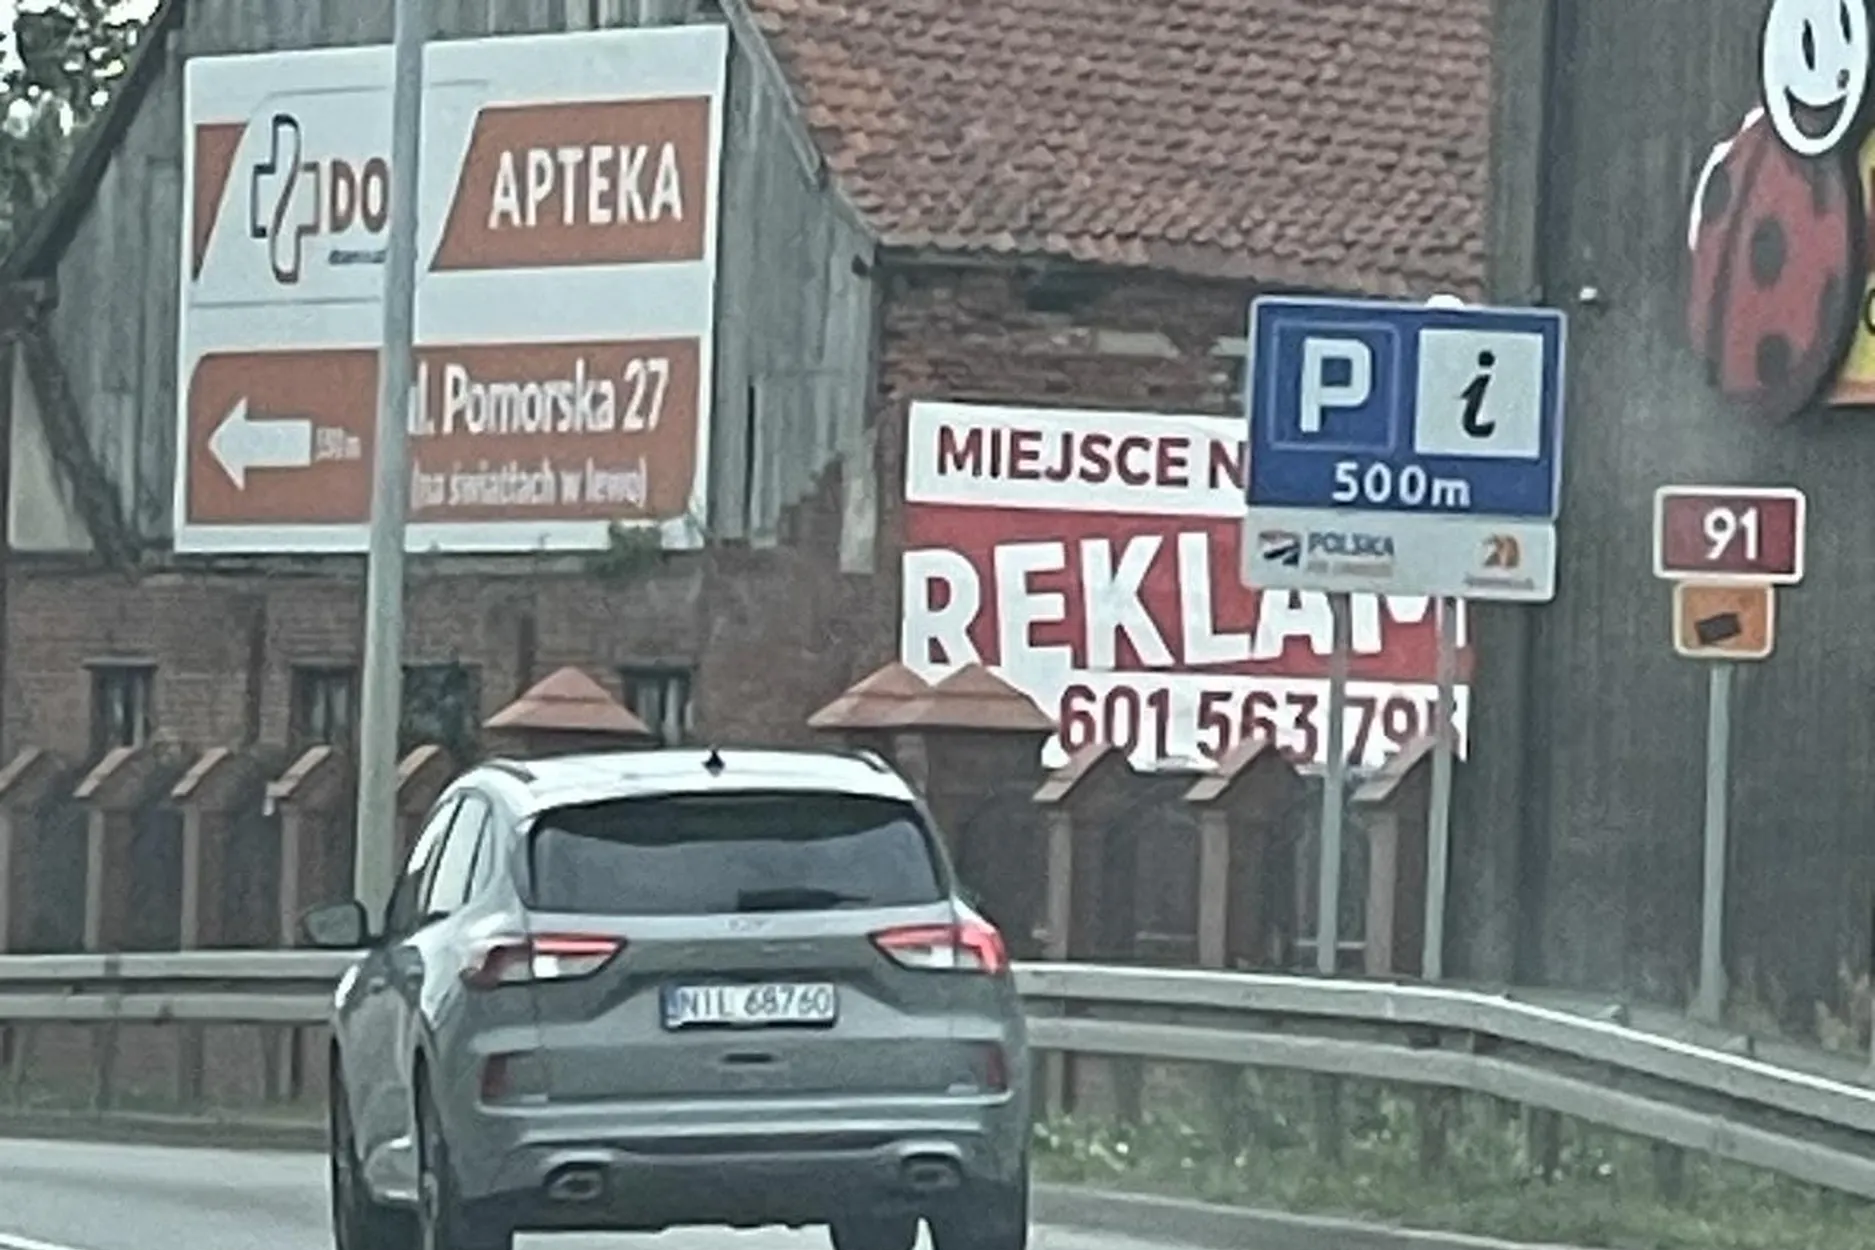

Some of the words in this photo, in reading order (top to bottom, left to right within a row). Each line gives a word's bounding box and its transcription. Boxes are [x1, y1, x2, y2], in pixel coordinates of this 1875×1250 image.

[329, 157, 390, 234] DO
[488, 141, 684, 230] APTEKA
[443, 357, 615, 435] Pomorska
[622, 357, 670, 431] 27
[1300, 336, 1373, 432] P
[1460, 350, 1496, 438] i
[937, 424, 1190, 488] MIEJSCE
[1208, 438, 1249, 490] N
[1332, 461, 1470, 507] 500m
[1703, 507, 1759, 560] 91
[1059, 684, 1172, 761] 601
[1196, 690, 1319, 766] 563
[680, 985, 736, 1017] NIL
